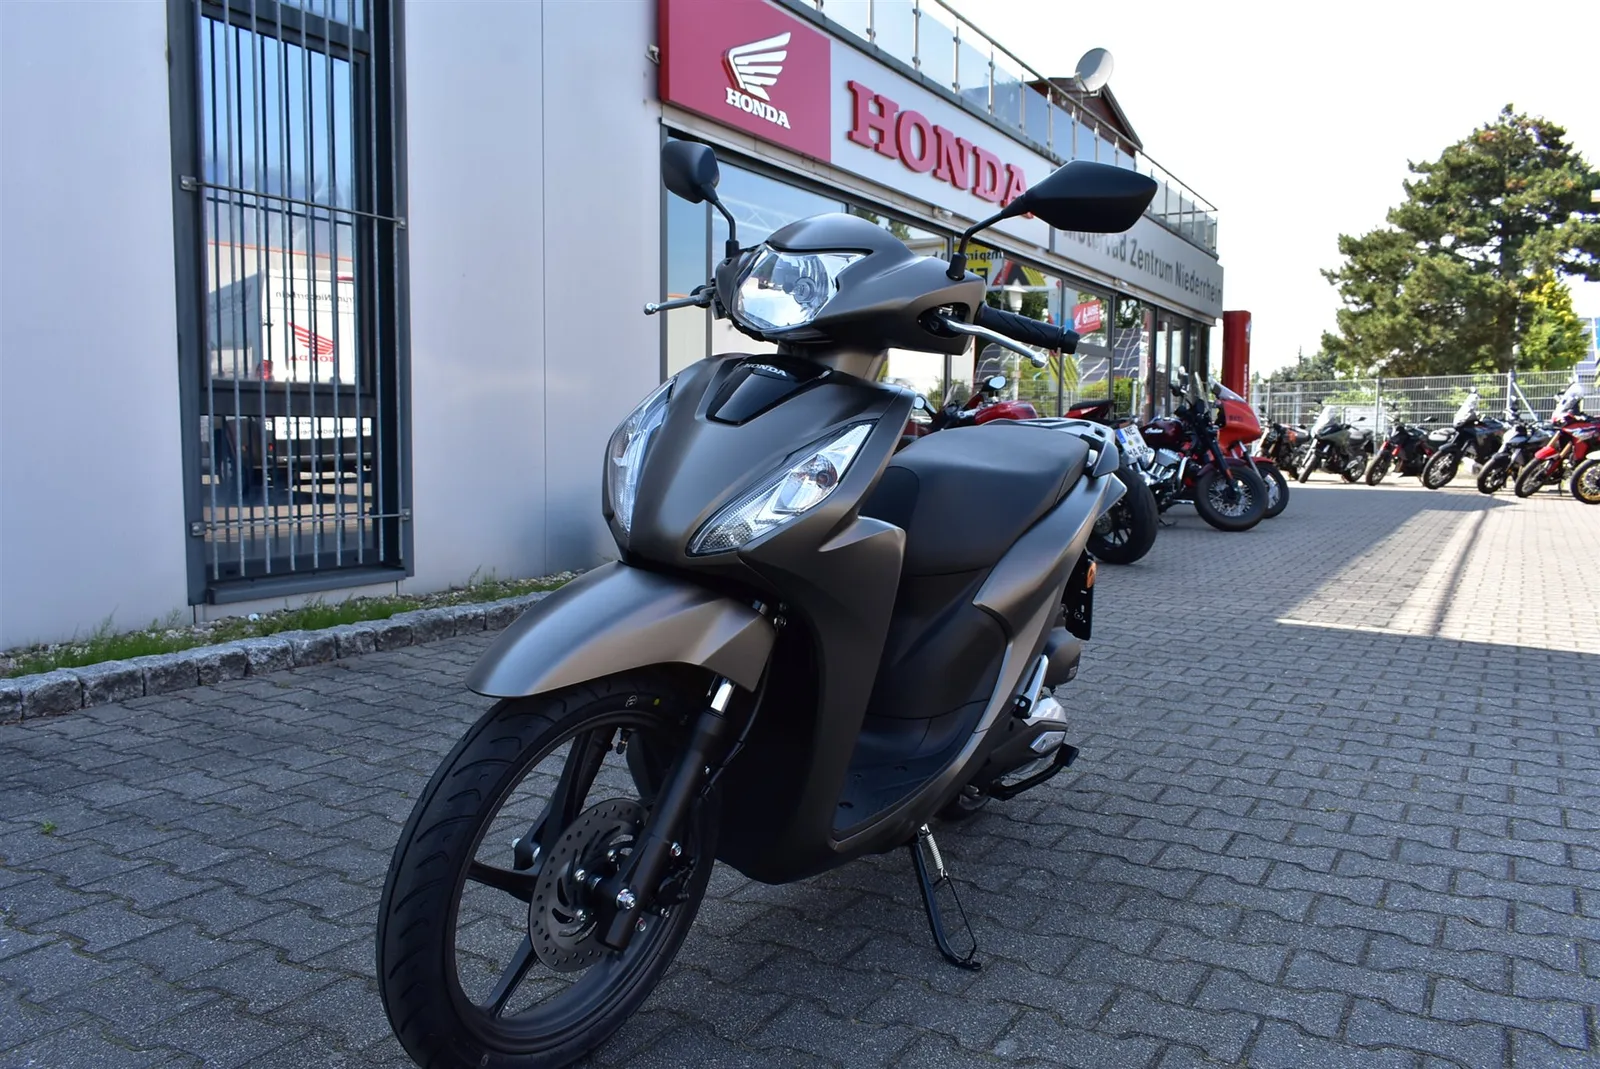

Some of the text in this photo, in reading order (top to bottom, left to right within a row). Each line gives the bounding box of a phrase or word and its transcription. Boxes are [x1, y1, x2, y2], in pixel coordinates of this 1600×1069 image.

[725, 86, 791, 130] HONDA
[847, 80, 1034, 219] HONDA
[1130, 238, 1173, 284] Zentrum
[1174, 260, 1222, 307] Niederrhein
[744, 363, 787, 377] HONDA
